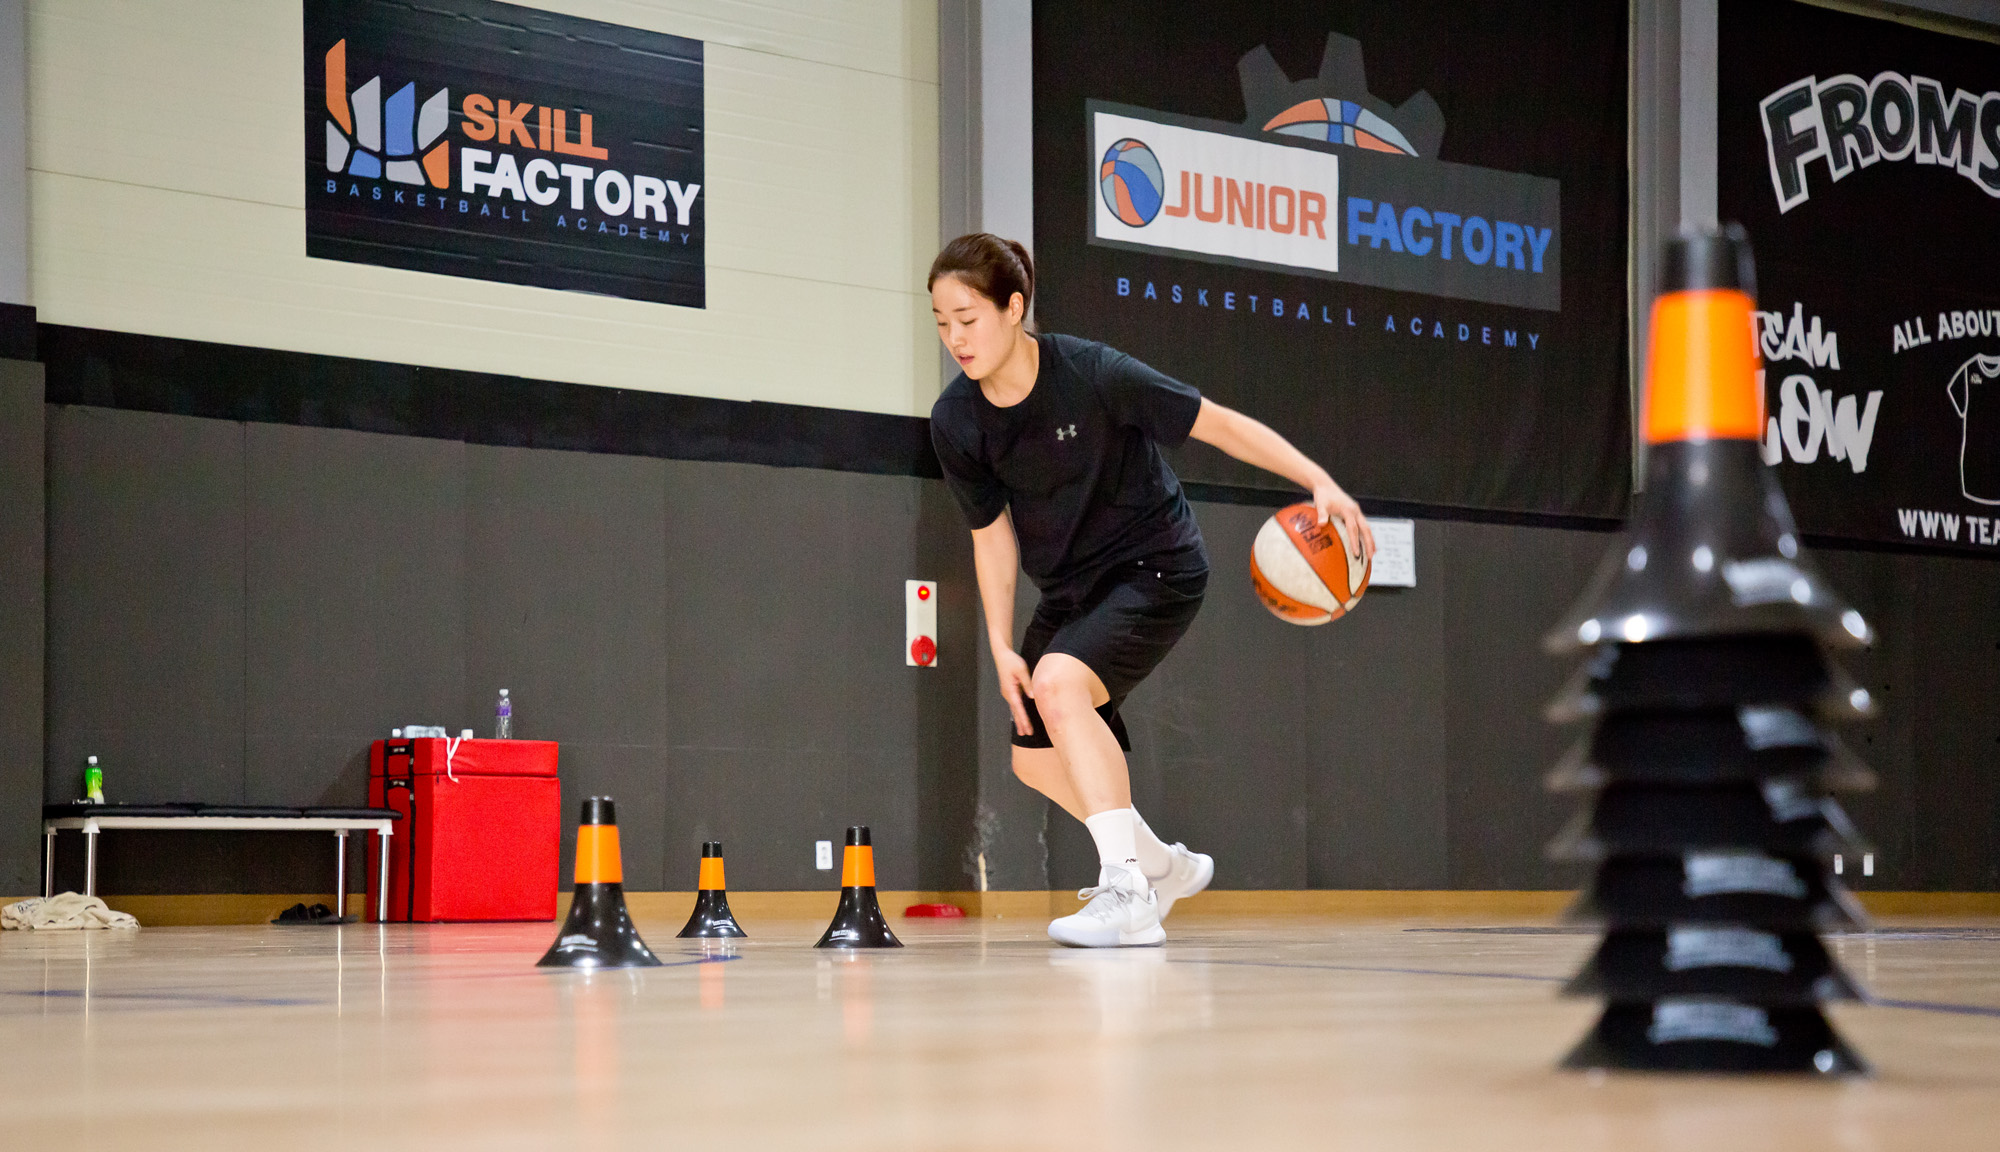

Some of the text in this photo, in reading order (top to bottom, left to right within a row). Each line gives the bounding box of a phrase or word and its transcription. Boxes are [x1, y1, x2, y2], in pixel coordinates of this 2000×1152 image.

[461, 93, 608, 161] SKILL
[327, 180, 691, 245] BASKETBALL ACADEMY
[461, 146, 701, 226] FACTORY
[1164, 170, 1553, 274] JUNIOR FACTORY
[1117, 277, 1541, 351] BASKETBALL ACADEMY
[1749, 301, 1841, 370] TEAM
[1893, 309, 2000, 354] ALL ABOUT
